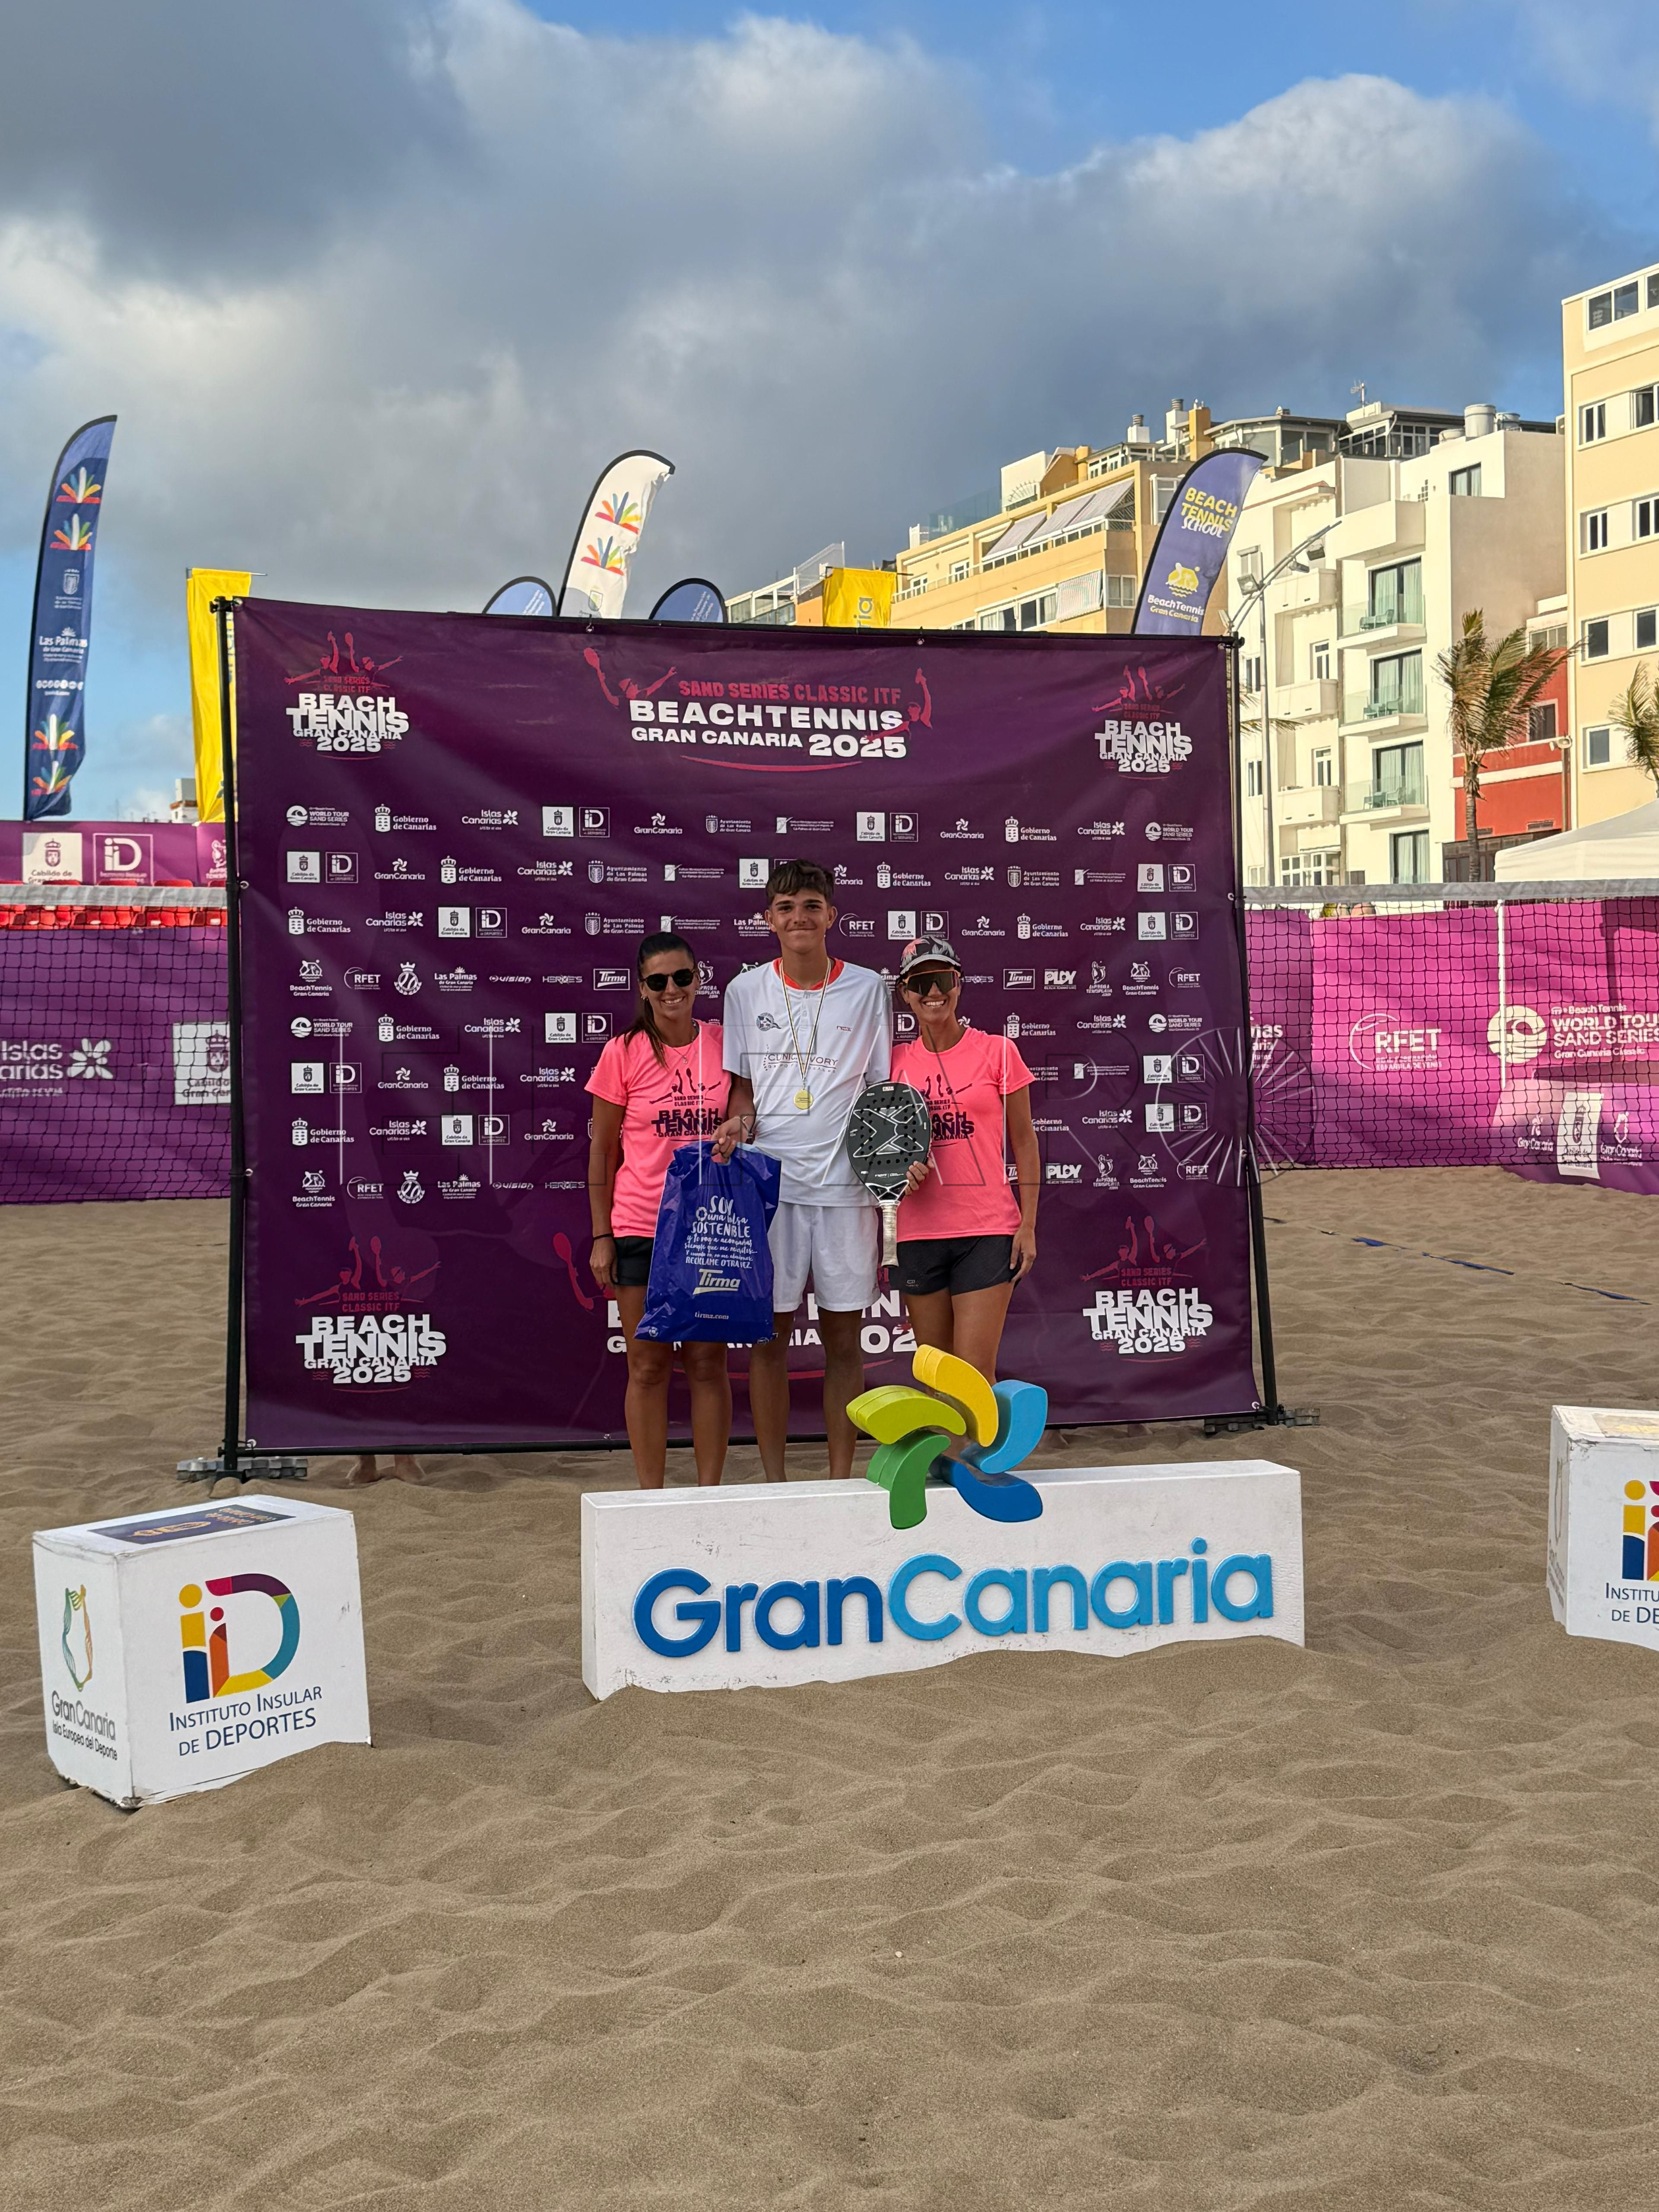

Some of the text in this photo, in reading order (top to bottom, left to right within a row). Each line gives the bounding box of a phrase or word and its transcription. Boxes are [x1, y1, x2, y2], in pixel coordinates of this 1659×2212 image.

[1185, 487, 1237, 518] BEACH
[1181, 502, 1233, 532] TENNIS
[1181, 516, 1224, 538] SCHOOL
[1148, 594, 1205, 616] BeachTennis
[1150, 606, 1199, 623] Gran Canaria
[39, 636, 54, 645] Las
[678, 680, 900, 705] SAND SERIES CLASSIC ITF
[299, 693, 395, 712] BEACH
[286, 708, 409, 733] TENNIS
[629, 699, 903, 731] BEACHTENNIS
[293, 728, 402, 740] GRAN CANARIA
[1105, 720, 1181, 735] BEACH
[317, 737, 381, 752] 2025
[631, 727, 907, 757] GRAN CANARIA 2025
[1095, 733, 1192, 755] TENNIS
[1100, 752, 1187, 762] GRAN CANARIA
[1118, 760, 1171, 773] 2025
[461, 816, 502, 824] Canarias
[1077, 827, 1111, 836] Canarias
[375, 872, 426, 880] GranCanaria
[365, 918, 407, 926] Canarias
[849, 921, 875, 931] RFET
[354, 974, 381, 983] RFET
[599, 971, 626, 982] Tirma
[1008, 971, 1033, 982] Tirma
[1177, 973, 1201, 982] RFET
[1568, 1005, 1597, 1014] Beach
[1598, 1003, 1627, 1013] Tennis
[464, 1024, 505, 1033] Canarias
[1552, 1013, 1659, 1032] WORLD TOU
[1375, 1029, 1442, 1054] RFET
[1554, 1031, 1602, 1047] SAND
[2, 1040, 63, 1061] Islas
[1554, 1050, 1576, 1058] Gran
[1577, 1048, 1611, 1058] Canaria
[810, 1056, 839, 1066] VORY
[0, 1062, 64, 1080] arias
[183, 1089, 209, 1098] Gran
[659, 1108, 718, 1120] BEACH
[932, 1111, 967, 1122] ACH
[651, 1117, 723, 1133] TENNIS
[931, 1120, 975, 1137] NNIS
[1186, 1165, 1208, 1175] RFET
[710, 1195, 734, 1216] SOY
[727, 1213, 748, 1226] blsa
[691, 1221, 750, 1238] SOSTENBLE
[721, 1259, 739, 1268] OTRA
[699, 1268, 741, 1288] Tirma
[1121, 1268, 1172, 1276] SAND SERIES
[1121, 1278, 1172, 1287] CLASSIC ITF
[343, 1292, 400, 1301] SAND SERIES
[1095, 1287, 1198, 1309] BEACH
[343, 1302, 400, 1312] CLASSIC ITF
[311, 1314, 430, 1337] BEACH
[1083, 1303, 1213, 1332] TENNIS
[1092, 1326, 1207, 1340] GRAN CANARIA
[296, 1331, 446, 1360] TENNIS
[1118, 1337, 1185, 1354] 2025
[304, 1355, 438, 1369] GRAN CANARIA
[333, 1366, 411, 1384] 2025
[633, 1536, 1274, 1658] GranCanaria
[1605, 1582, 1659, 1602] INSTITU
[1611, 1609, 1630, 1622] DE
[52, 1690, 116, 1741] GranCanaria
[169, 1686, 322, 1731] INSTITUTO INSULAR
[53, 1719, 118, 1761] Isla Europea del Deporte
[178, 1708, 317, 1756] DE DEPORTES
